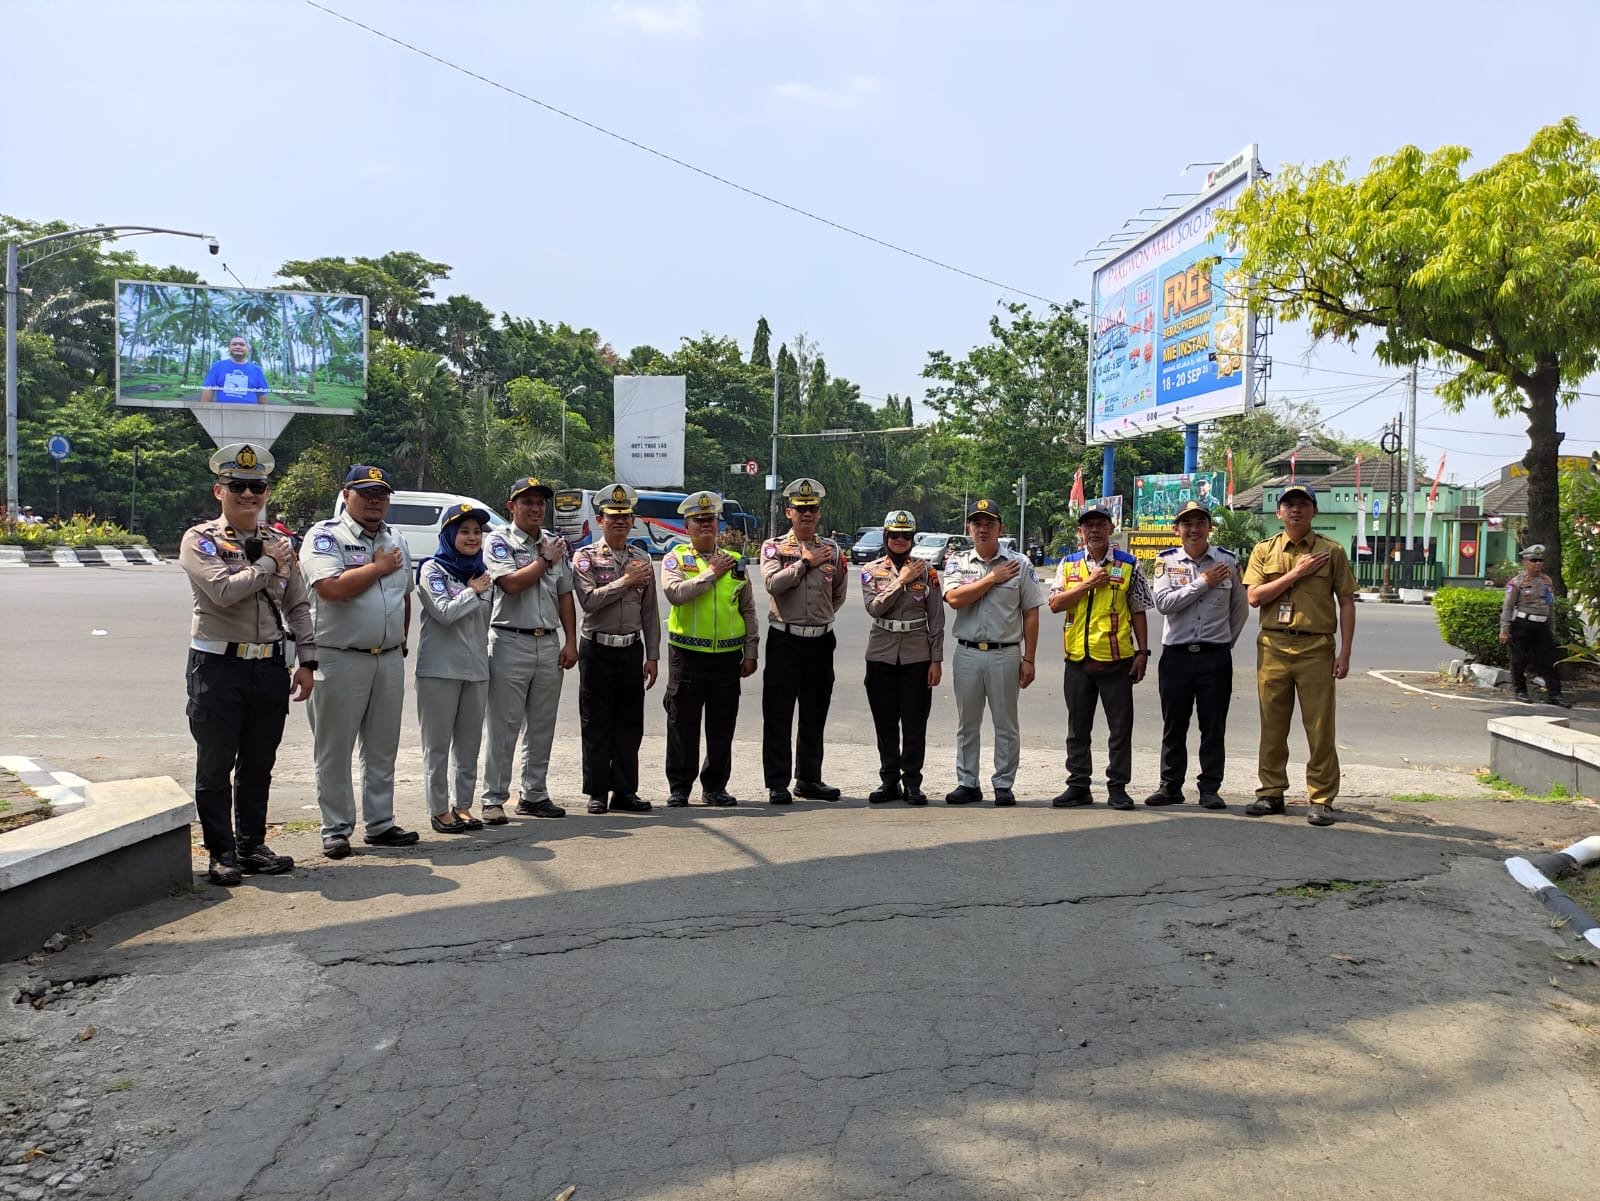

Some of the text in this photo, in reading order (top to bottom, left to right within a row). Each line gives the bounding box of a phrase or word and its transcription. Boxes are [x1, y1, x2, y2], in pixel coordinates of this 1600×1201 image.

[1150, 230, 1175, 257] MALL
[1177, 215, 1202, 244] SOLO
[1204, 196, 1233, 229] BU
[1162, 263, 1212, 323] FREE
[1181, 310, 1211, 332] PREMIUM
[1162, 331, 1210, 364] MIE INSTAN
[1162, 376, 1171, 392] 18
[1176, 372, 1186, 388] 20
[1138, 522, 1173, 531] Silaturah
[1129, 548, 1159, 561] AJENRE
